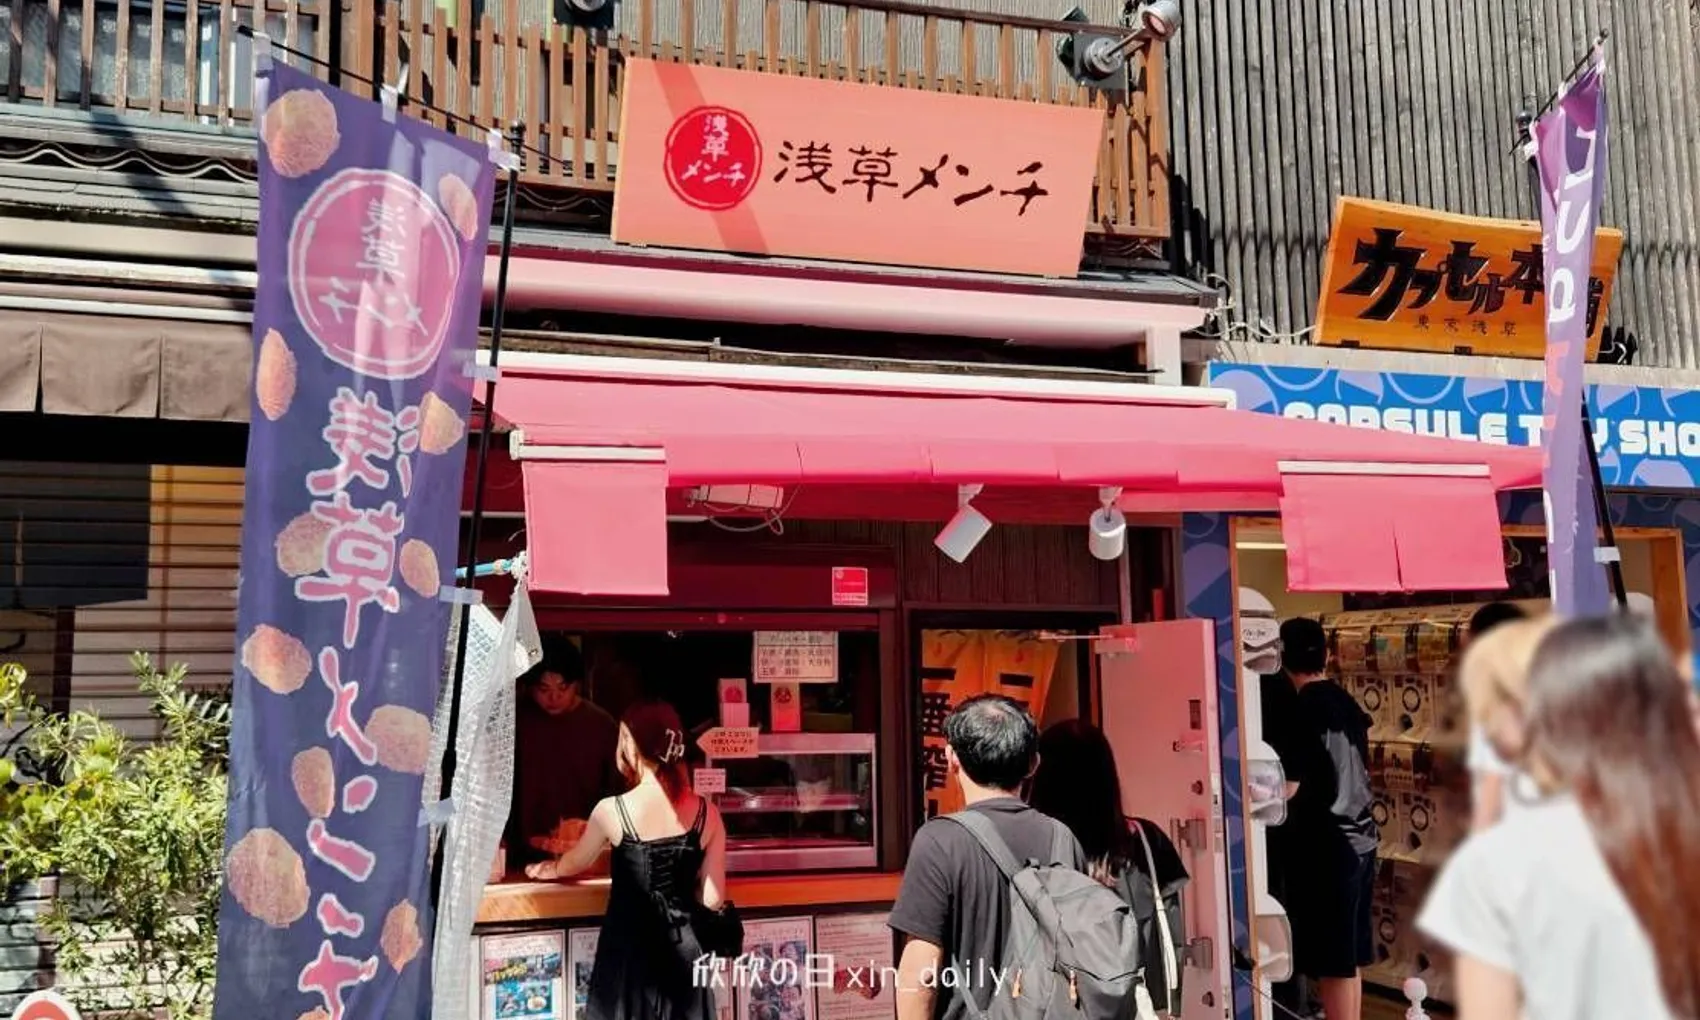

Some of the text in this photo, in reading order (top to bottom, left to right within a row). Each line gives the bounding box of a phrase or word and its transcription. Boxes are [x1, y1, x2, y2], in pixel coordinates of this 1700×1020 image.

[701, 114, 730, 162] 浅草
[681, 159, 746, 188] メンチ
[773, 139, 1049, 216] 浅草メンチ
[1518, 414, 1609, 453] TY
